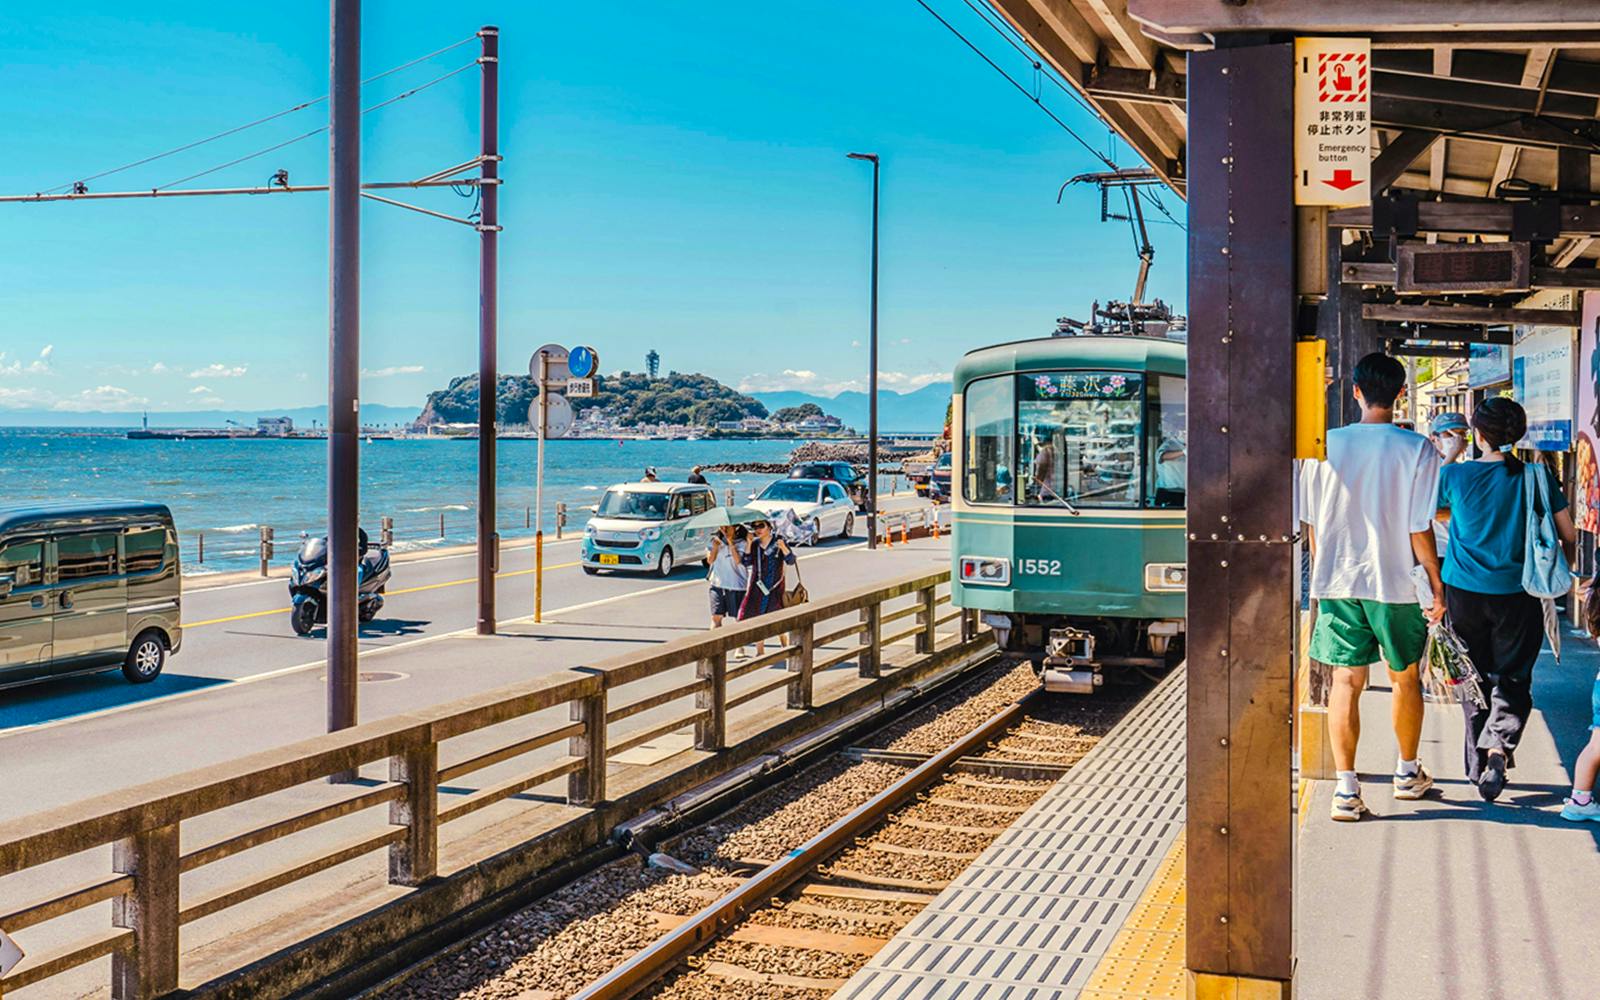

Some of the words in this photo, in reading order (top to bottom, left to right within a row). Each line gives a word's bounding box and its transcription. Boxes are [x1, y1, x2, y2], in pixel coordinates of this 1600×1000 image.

[1319, 111, 1366, 122] 非常列車
[1307, 124, 1366, 135] 停止ボタン
[1318, 143, 1366, 153] Emergency
[1318, 154, 1348, 162] button
[1018, 559, 1062, 576] 1552
